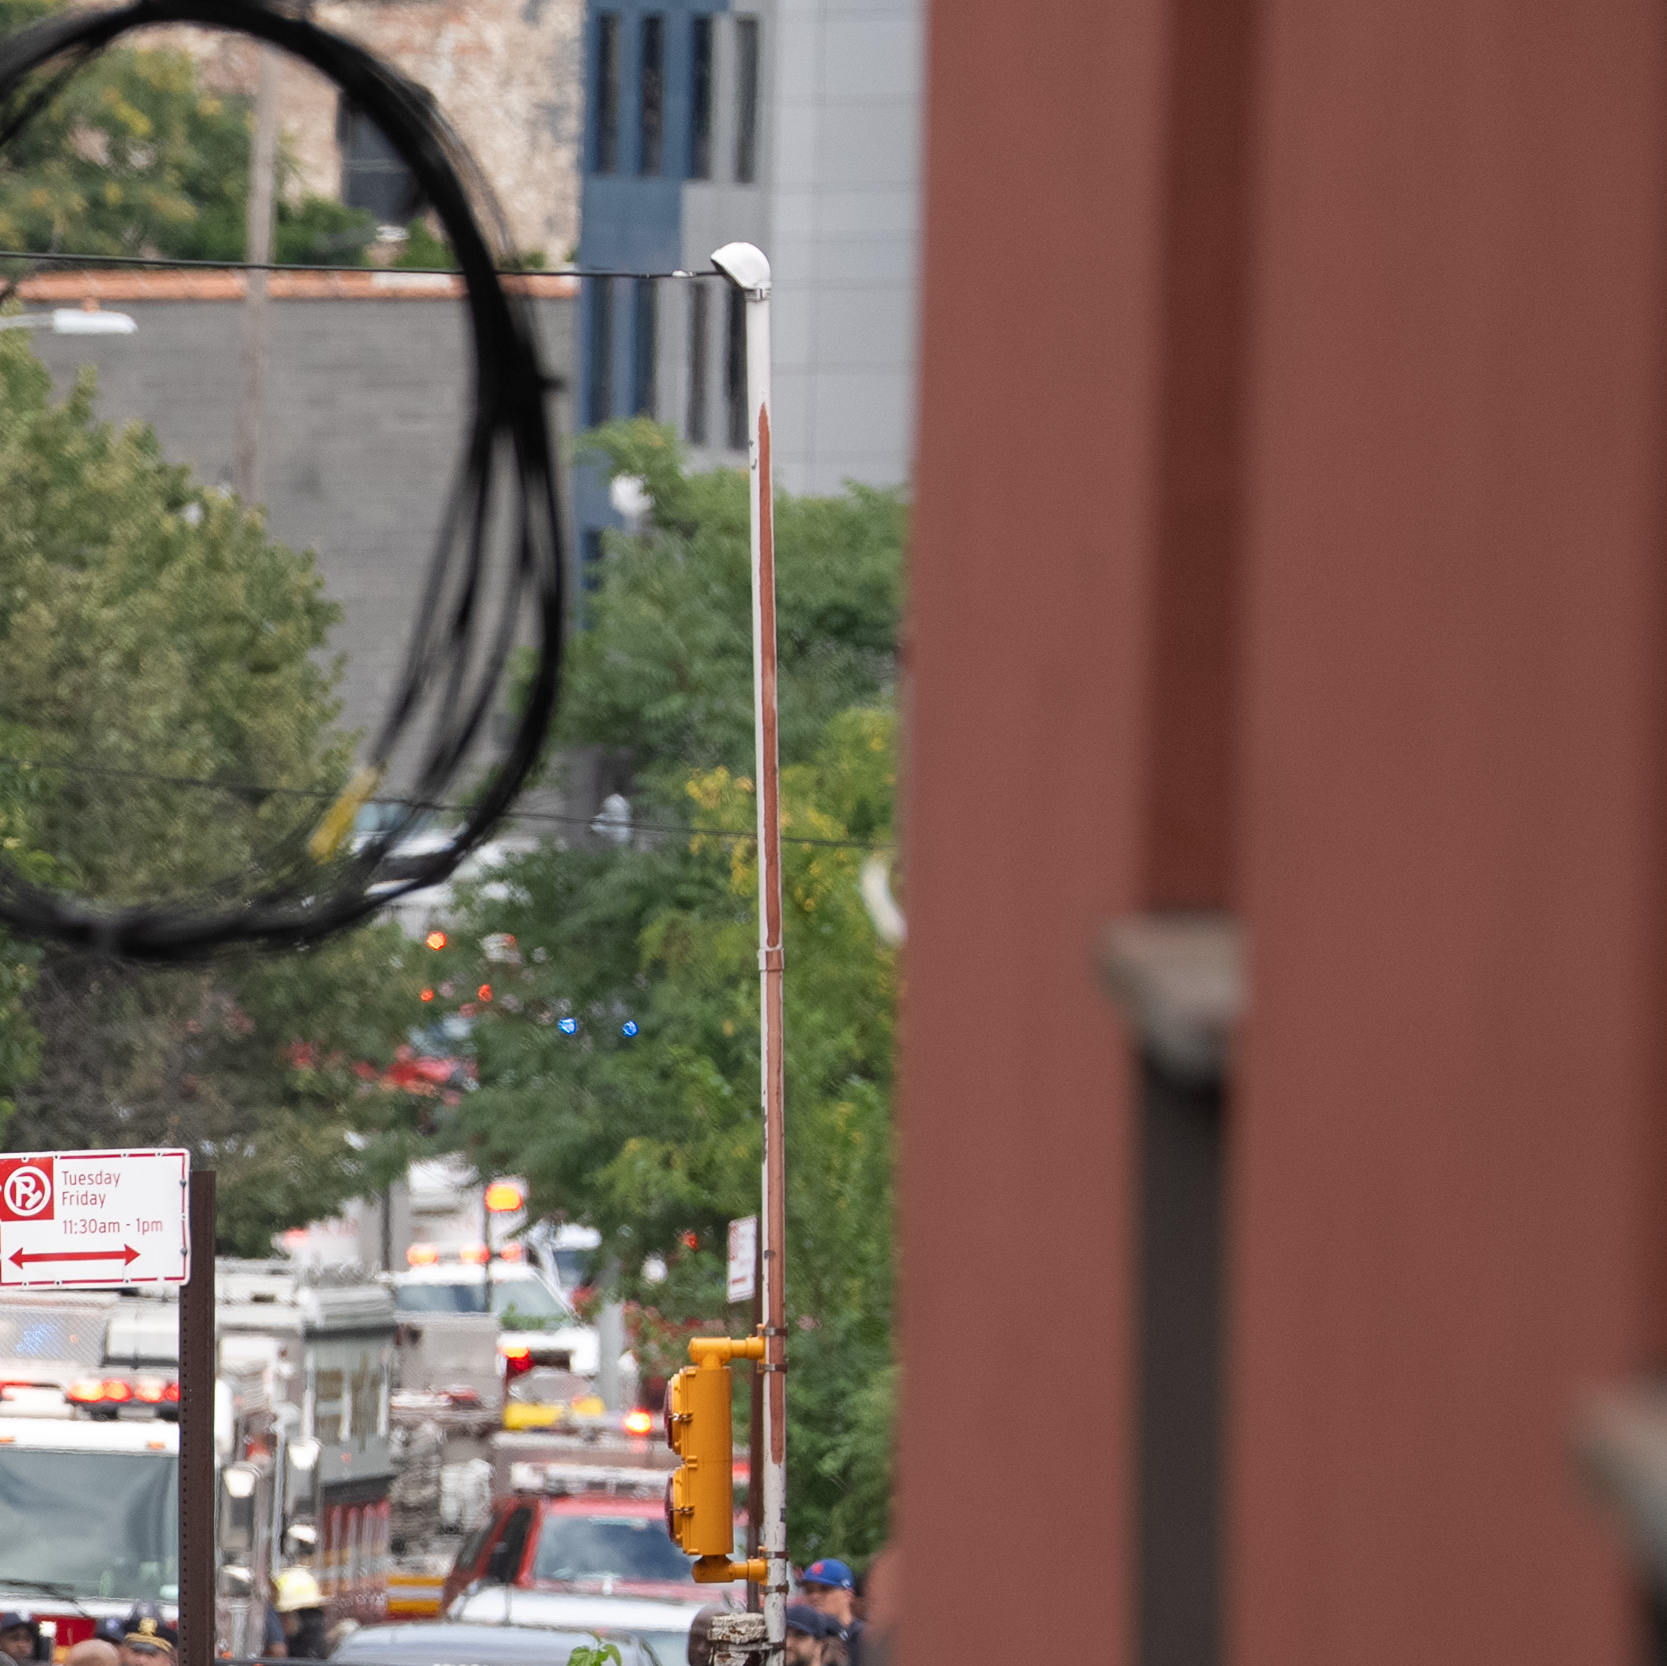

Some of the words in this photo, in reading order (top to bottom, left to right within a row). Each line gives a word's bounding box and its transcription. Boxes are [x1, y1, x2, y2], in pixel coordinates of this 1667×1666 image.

[62, 1170, 121, 1188] Tuesday
[62, 1191, 107, 1208] Friday
[62, 1218, 121, 1235] 11:30am
[136, 1217, 163, 1235] 1pm
